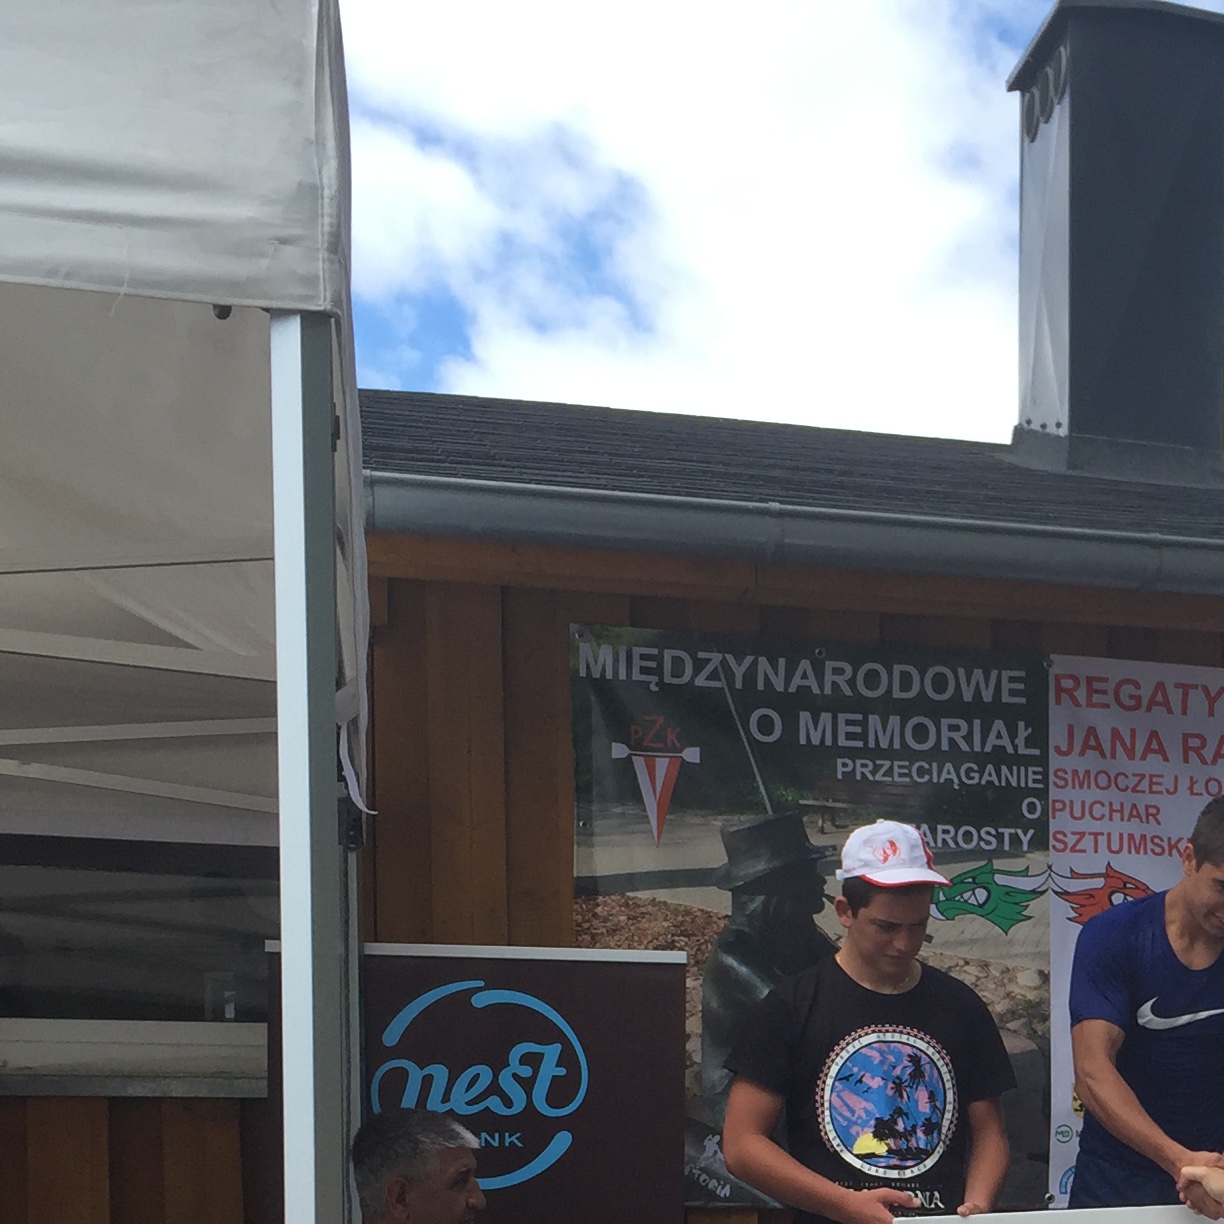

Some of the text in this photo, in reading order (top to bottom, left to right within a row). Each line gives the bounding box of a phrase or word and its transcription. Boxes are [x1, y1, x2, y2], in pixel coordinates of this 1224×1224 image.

[578, 642, 1027, 704] MIĘDZYNARODOWE
[630, 714, 682, 748] PZK
[749, 707, 1040, 756] O MEMORIAŁ
[1053, 724, 1170, 763] JANA
[836, 757, 1044, 790] PRZECIĄGANIE
[1052, 768, 1179, 796] SMOCZEJ
[1022, 796, 1042, 820] O
[1051, 800, 1161, 826] PUCHAR
[913, 823, 1035, 852] AROSTY
[1051, 831, 1190, 859] SZTUMSK
[371, 1042, 568, 1117] nest
[480, 1132, 524, 1148] NK
